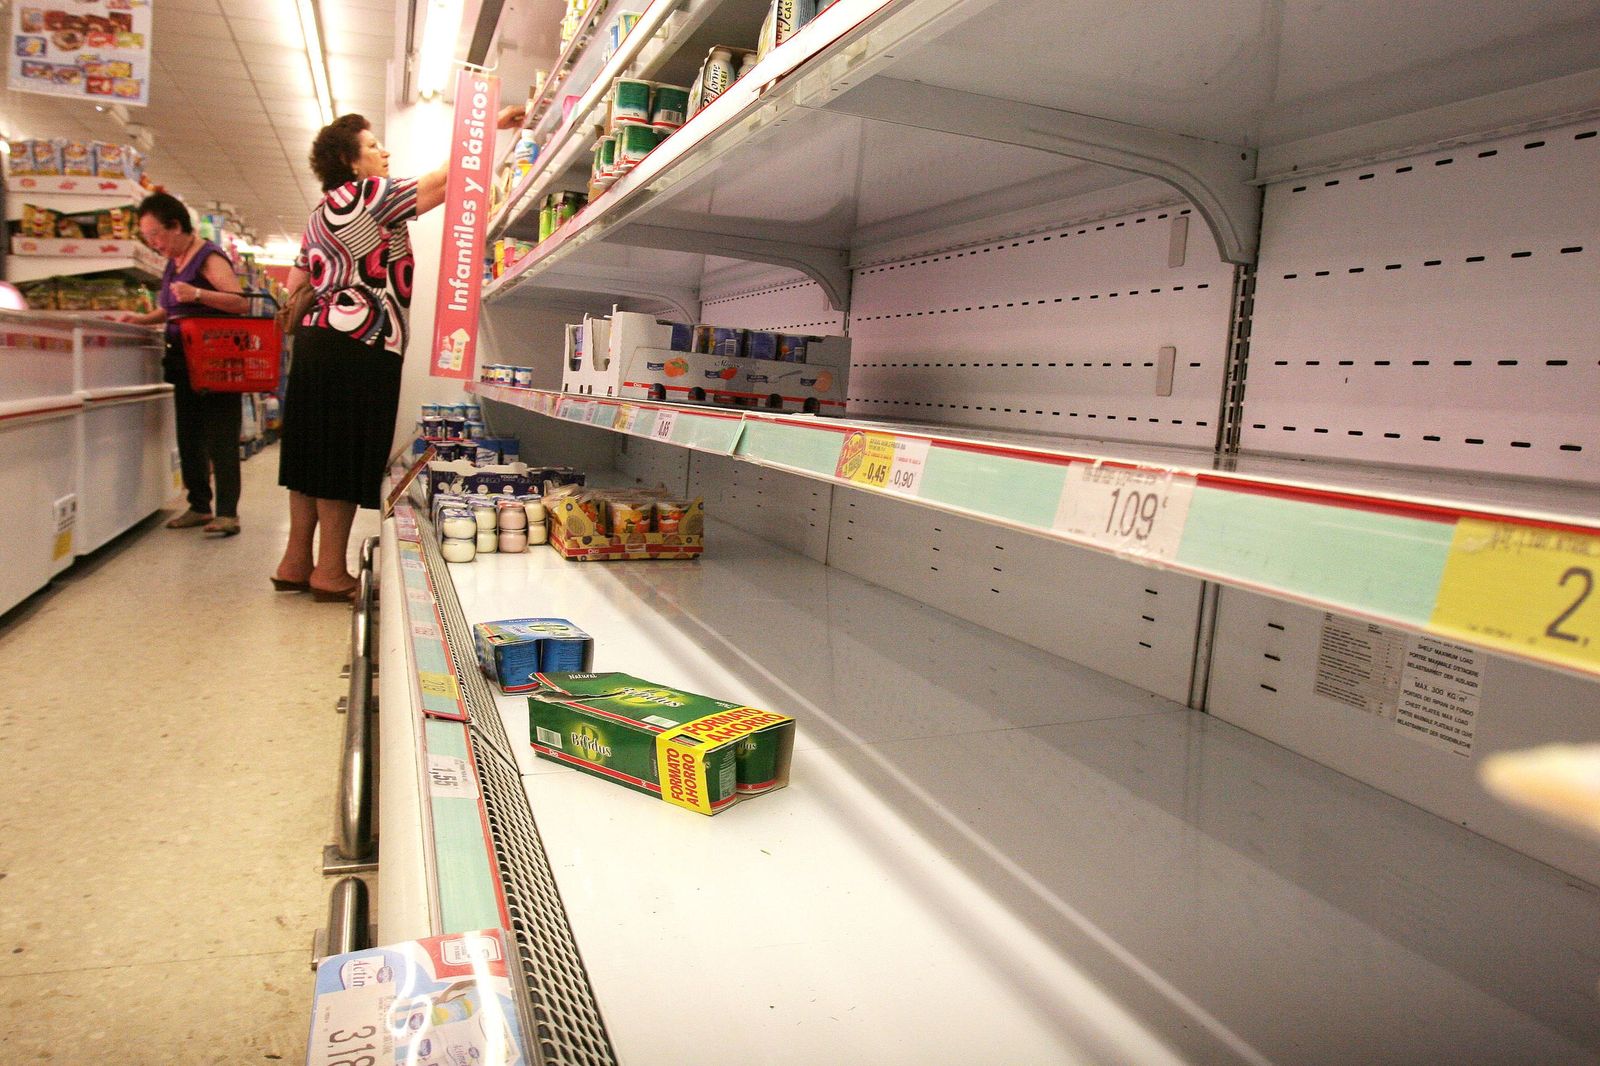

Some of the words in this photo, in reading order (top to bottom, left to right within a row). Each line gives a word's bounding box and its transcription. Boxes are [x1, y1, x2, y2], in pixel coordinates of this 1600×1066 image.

[784, 0, 793, 20] CAS
[461, 81, 489, 171] Básicos
[464, 176, 484, 193] y
[447, 199, 477, 312] Infantiles
[1431, 686, 1444, 696] 300
[681, 708, 764, 736] FORMATO
[705, 713, 785, 742] AHORRO
[571, 731, 612, 758] Bifidus
[666, 747, 684, 802] FORMATO
[682, 753, 700, 808] AHORRO
